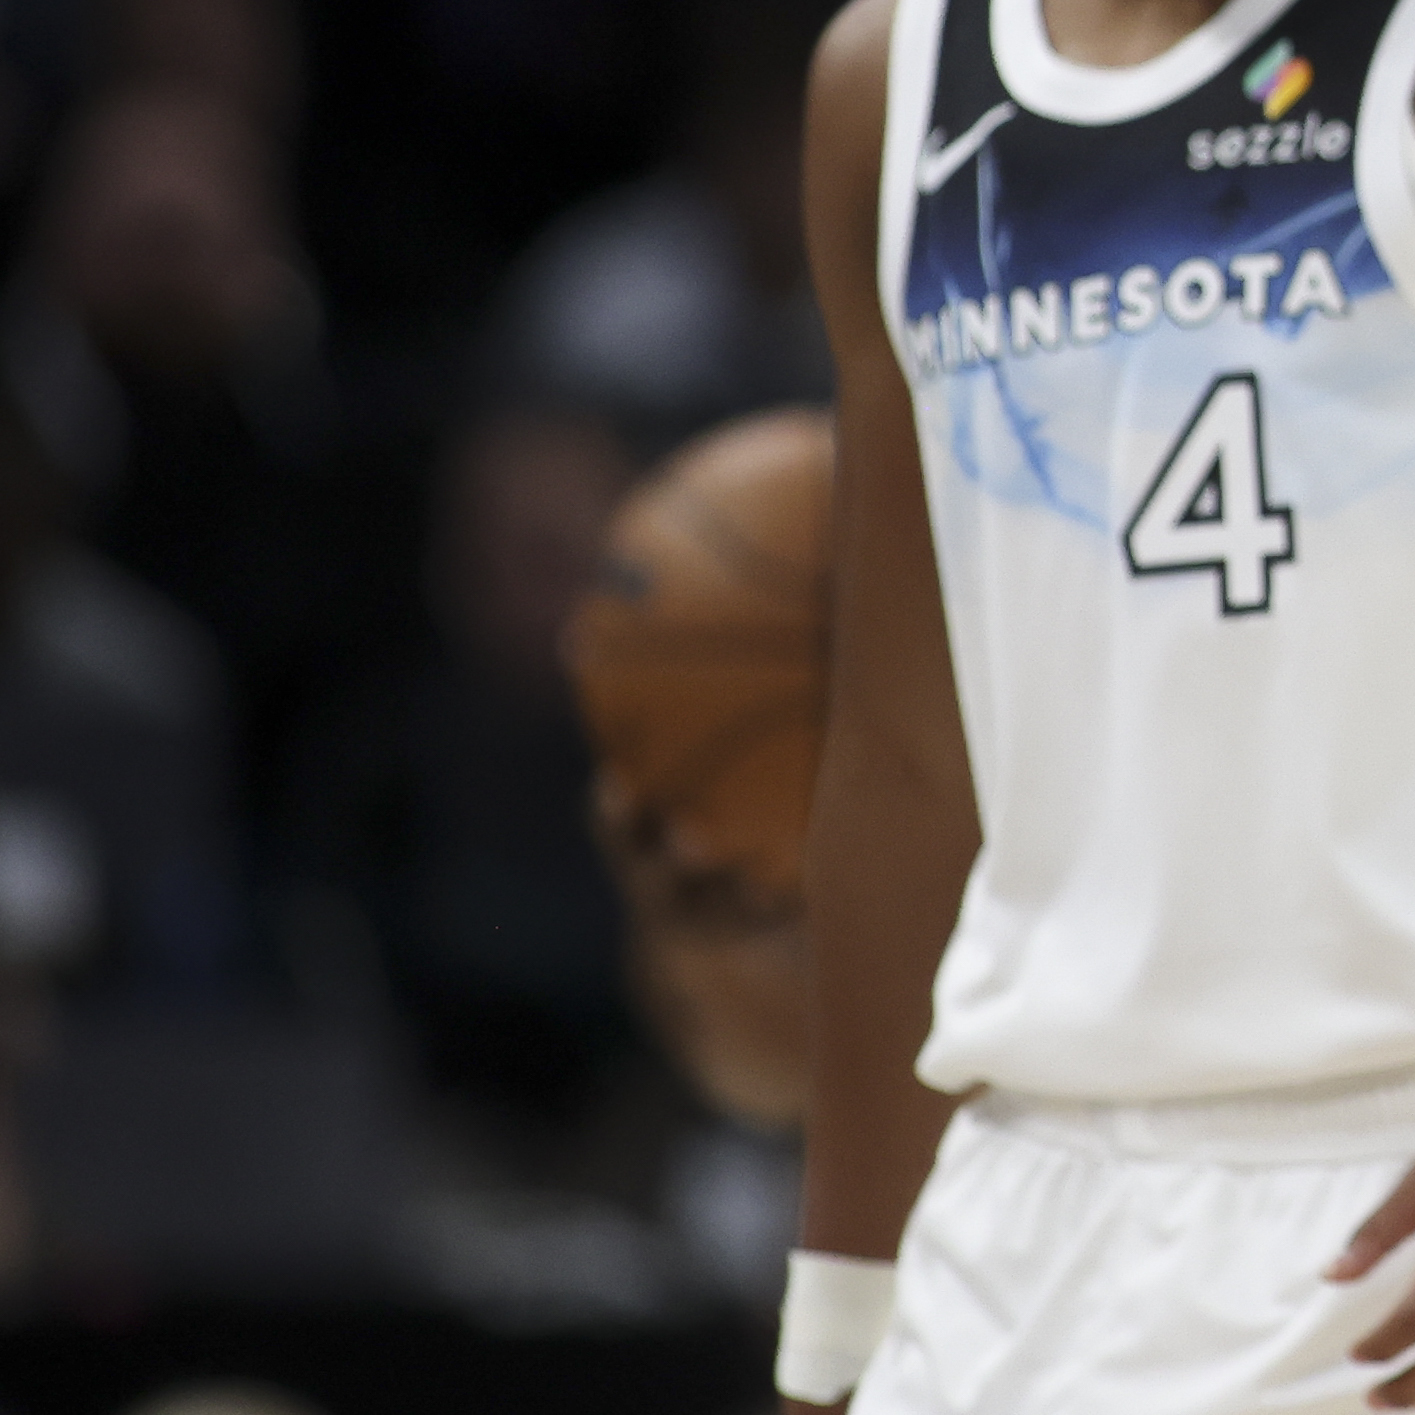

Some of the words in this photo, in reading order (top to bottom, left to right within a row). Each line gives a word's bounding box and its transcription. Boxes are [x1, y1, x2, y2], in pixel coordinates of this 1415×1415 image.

[1187, 112, 1350, 171] sezzle
[907, 248, 1347, 377] MINNESOTA
[1122, 371, 1296, 617] 4
